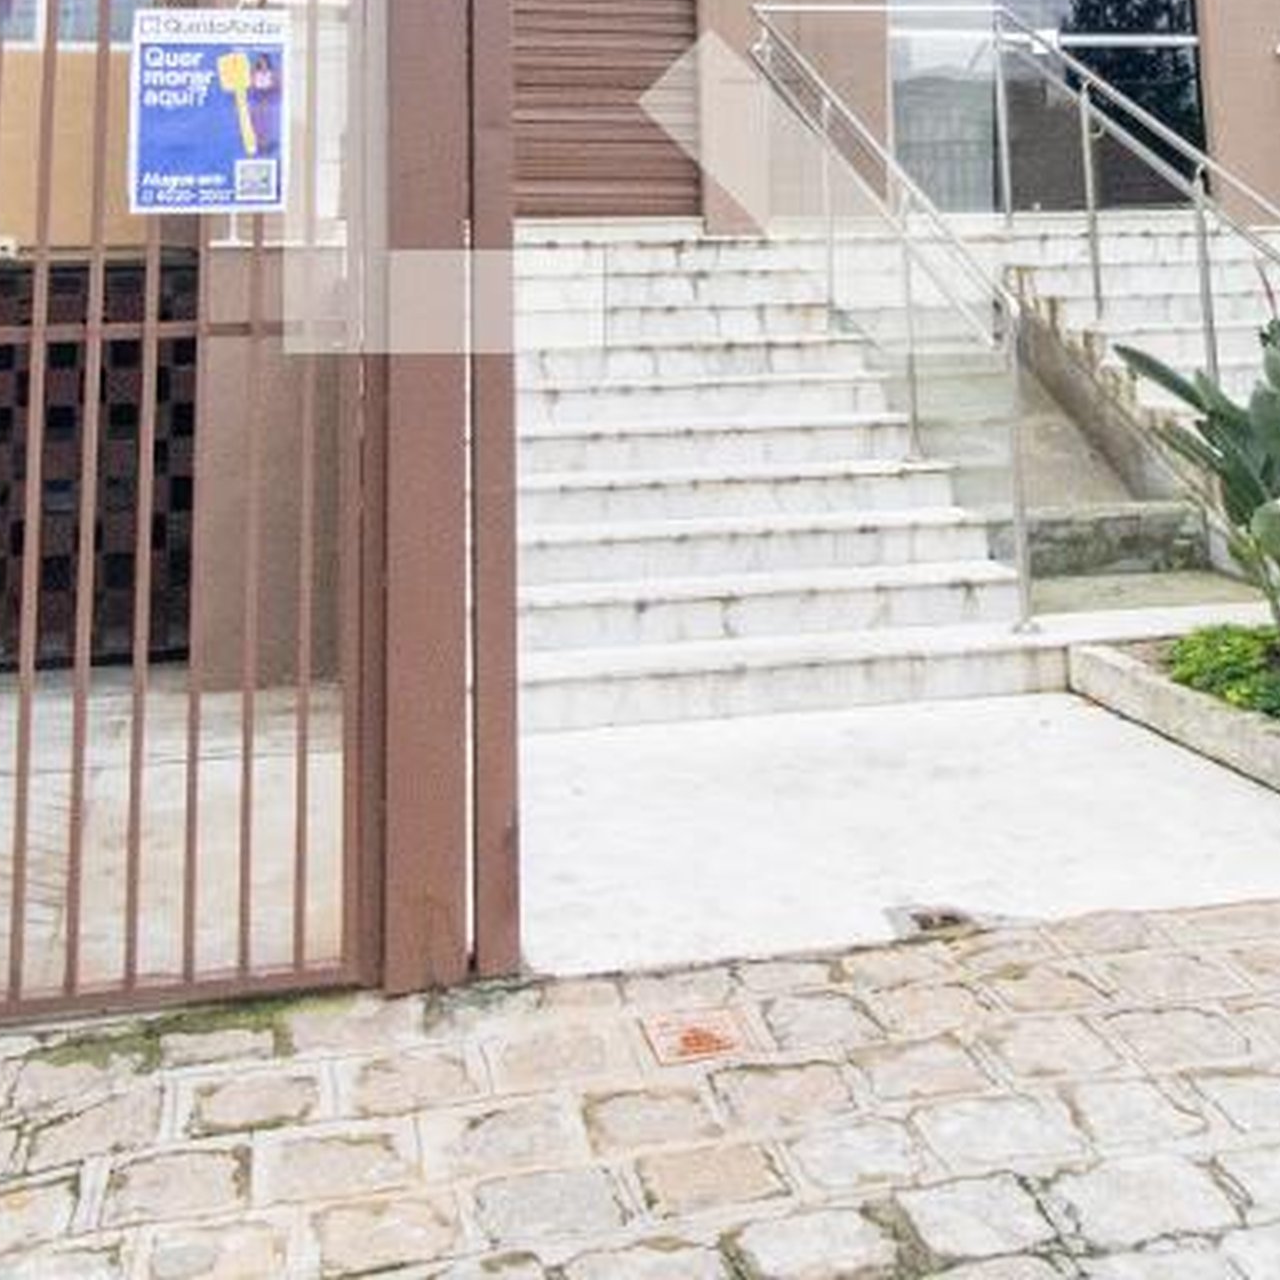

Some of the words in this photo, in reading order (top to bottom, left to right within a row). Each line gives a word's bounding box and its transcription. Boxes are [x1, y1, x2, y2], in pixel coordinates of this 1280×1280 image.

[145, 46, 204, 67] Quer
[143, 70, 214, 86] morar
[143, 86, 208, 108] aqui?
